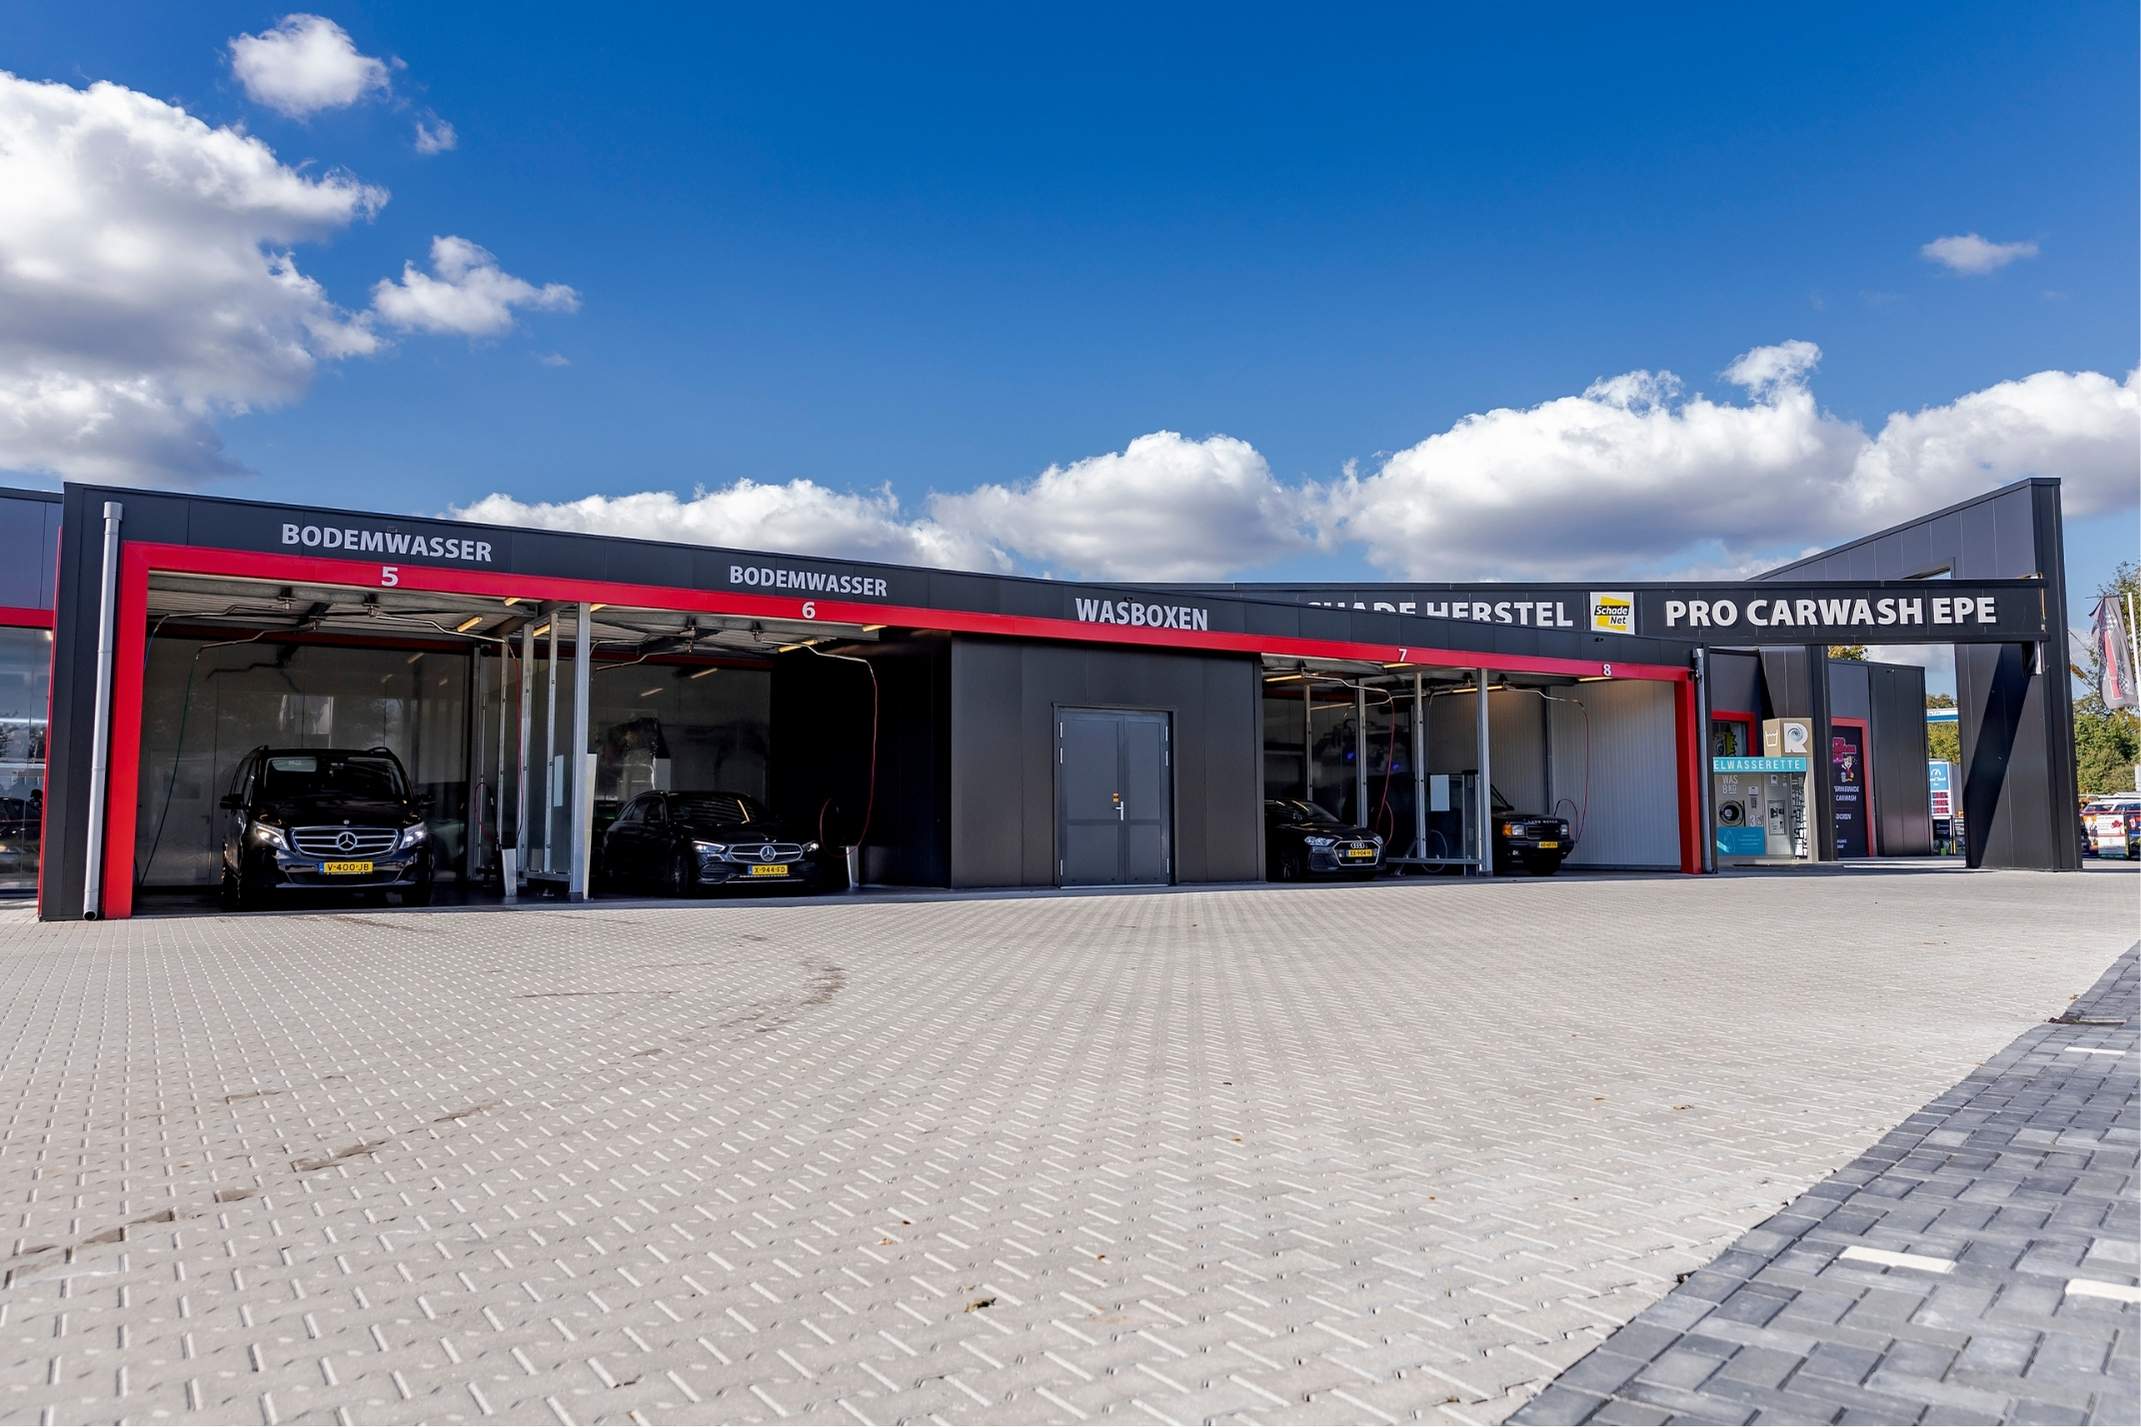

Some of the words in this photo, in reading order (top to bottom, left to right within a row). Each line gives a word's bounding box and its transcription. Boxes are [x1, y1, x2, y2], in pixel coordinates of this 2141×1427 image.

[282, 523, 492, 562] BODEMWASSER
[381, 566, 399, 587] 5
[730, 565, 887, 597] BODEMWASSER
[801, 601, 816, 619] 6
[1075, 598, 1208, 631] WASBOXEN
[1595, 606, 1628, 615] Schade
[1666, 600, 1738, 627] PRO
[1746, 598, 1923, 626] CARWASH
[1932, 596, 1997, 624] EPE
[1610, 616, 1626, 625] Net
[1398, 648, 1407, 662] 7
[1603, 663, 1612, 677] 8
